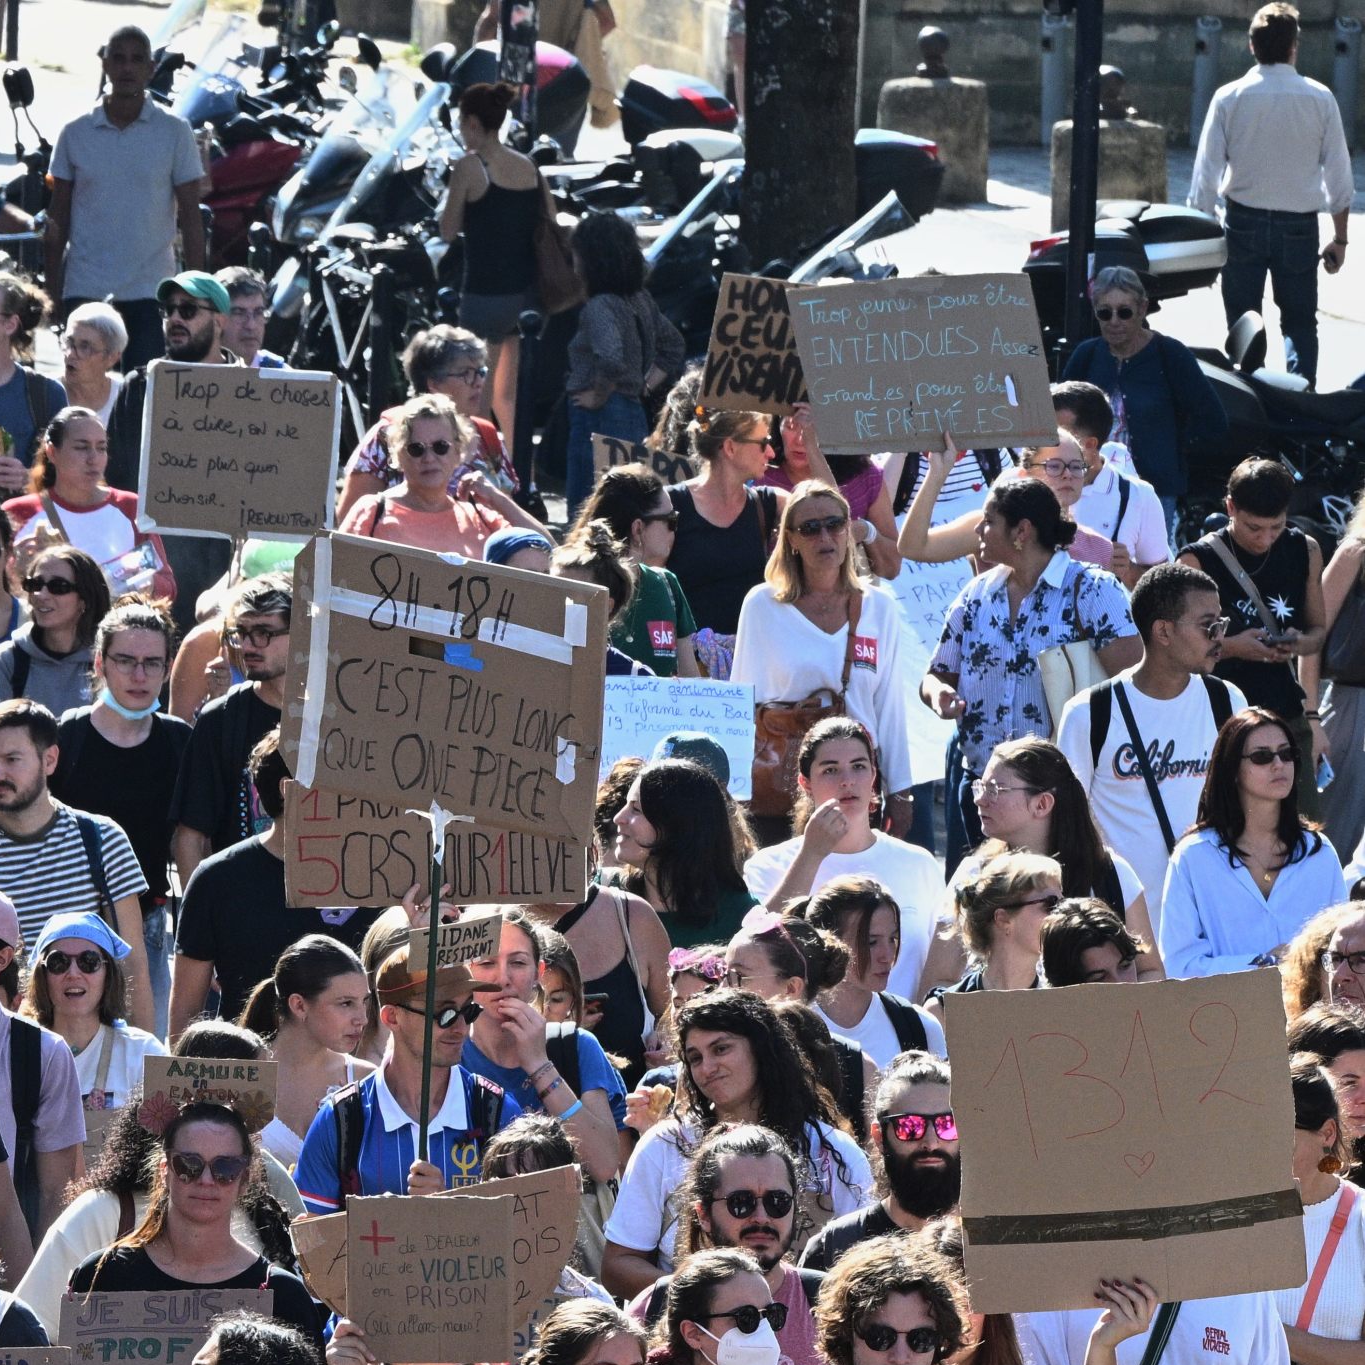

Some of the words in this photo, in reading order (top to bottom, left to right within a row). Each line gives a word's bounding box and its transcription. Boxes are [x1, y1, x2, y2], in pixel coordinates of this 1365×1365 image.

[799, 299, 851, 325] Trop
[927, 292, 979, 320] pour
[983, 284, 1030, 307] être
[991, 327, 1040, 357] Assez
[235, 381, 263, 402] de
[271, 383, 331, 407] choses
[915, 382, 967, 405] pour
[162, 411, 183, 431] à
[855, 643, 875, 660] SAF
[605, 680, 661, 697] anifesté
[335, 657, 438, 723] C'EST
[444, 674, 504, 740] PLUS
[512, 698, 581, 758] LONG
[689, 706, 716, 719] du
[722, 702, 752, 721] Bac
[703, 725, 720, 735] ne
[726, 726, 750, 738] nous
[323, 727, 378, 772] QUE
[391, 733, 460, 799] ONE
[469, 745, 557, 822] PIECE
[300, 788, 331, 822] 1
[297, 834, 342, 896] 5
[341, 830, 416, 900] CRS
[490, 831, 509, 897] 1
[508, 829, 576, 897] ELEVE
[166, 1058, 260, 1083] ARMURE
[983, 1001, 1267, 1161] 1312
[398, 1236, 416, 1255] de
[424, 1234, 481, 1251] DEALEUR
[362, 1261, 390, 1278] QUE
[397, 1260, 415, 1276] de
[419, 1255, 507, 1284] VIOLEUR
[371, 1286, 395, 1298] en
[404, 1282, 489, 1309] PRISON
[76, 1295, 124, 1327] JE
[94, 1337, 194, 1364] PROF
